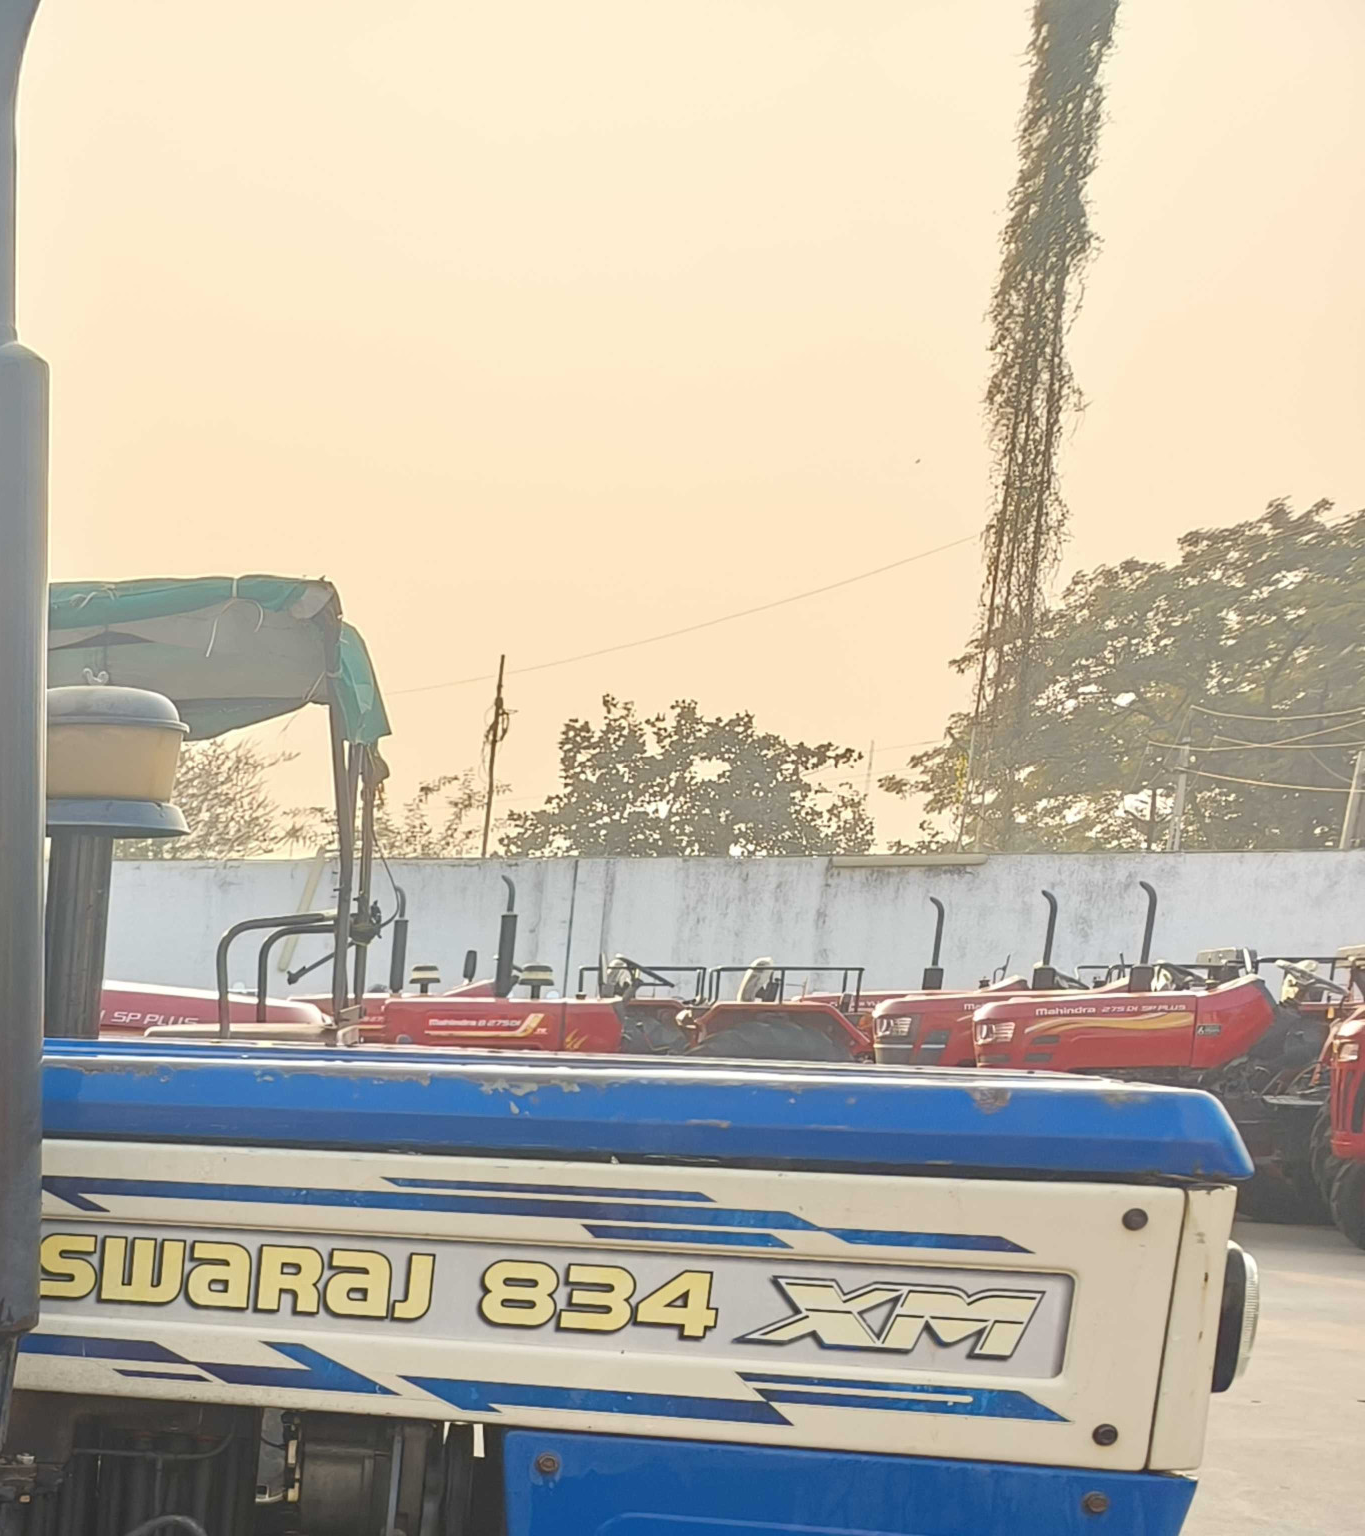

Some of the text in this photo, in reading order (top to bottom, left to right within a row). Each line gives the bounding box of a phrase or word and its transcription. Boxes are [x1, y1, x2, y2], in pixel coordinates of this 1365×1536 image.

[111, 1011, 141, 1023] SP
[1035, 1006, 1097, 1016] Mahindra
[478, 1258, 720, 1338] 834
[733, 1273, 1047, 1361] XM
